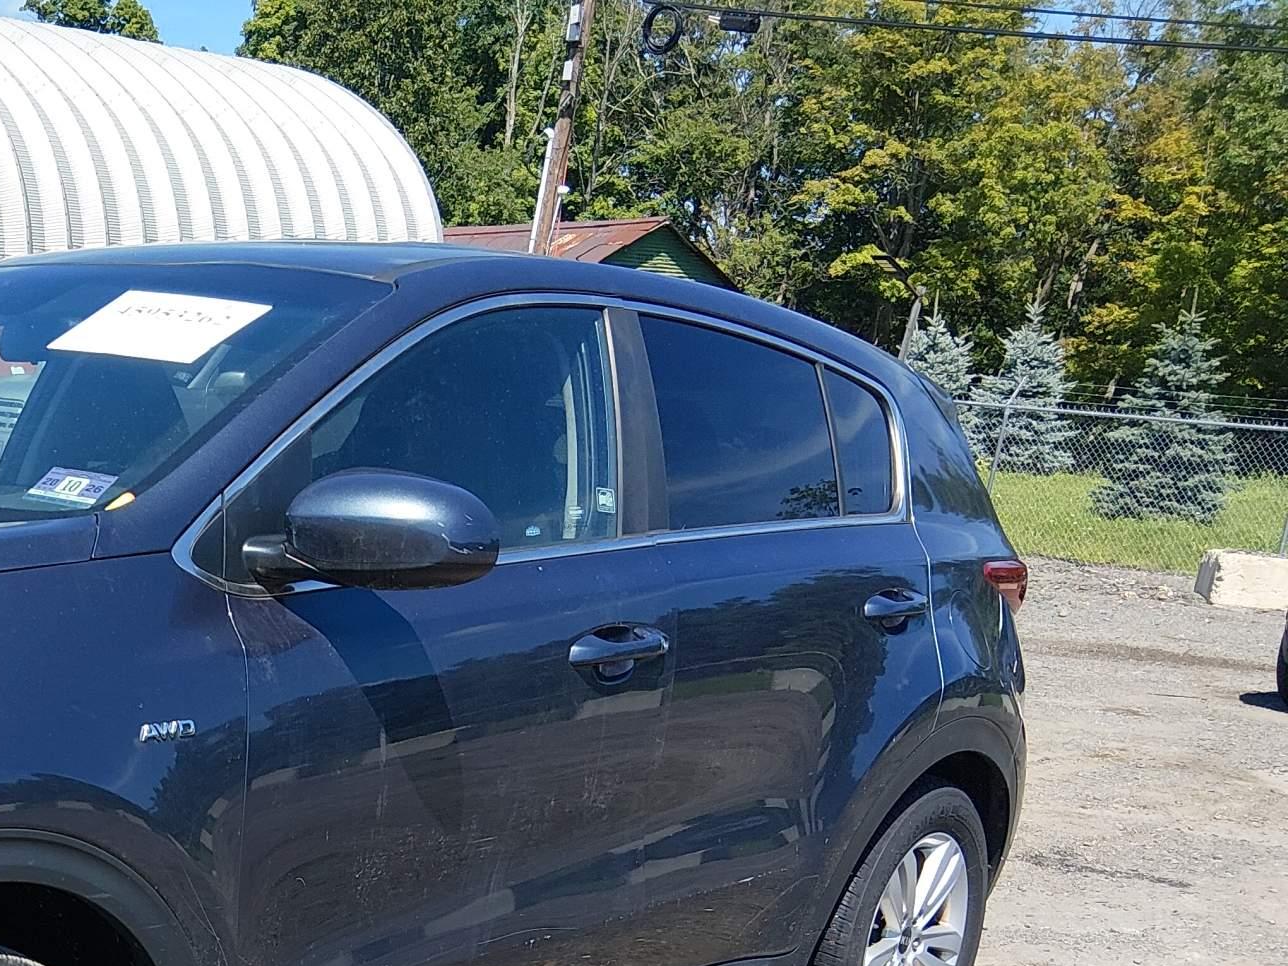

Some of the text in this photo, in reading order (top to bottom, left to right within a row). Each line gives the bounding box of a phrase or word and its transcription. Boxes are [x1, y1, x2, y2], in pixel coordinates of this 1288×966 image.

[40, 477, 104, 494] 20 10 26
[139, 719, 196, 742] AWD
